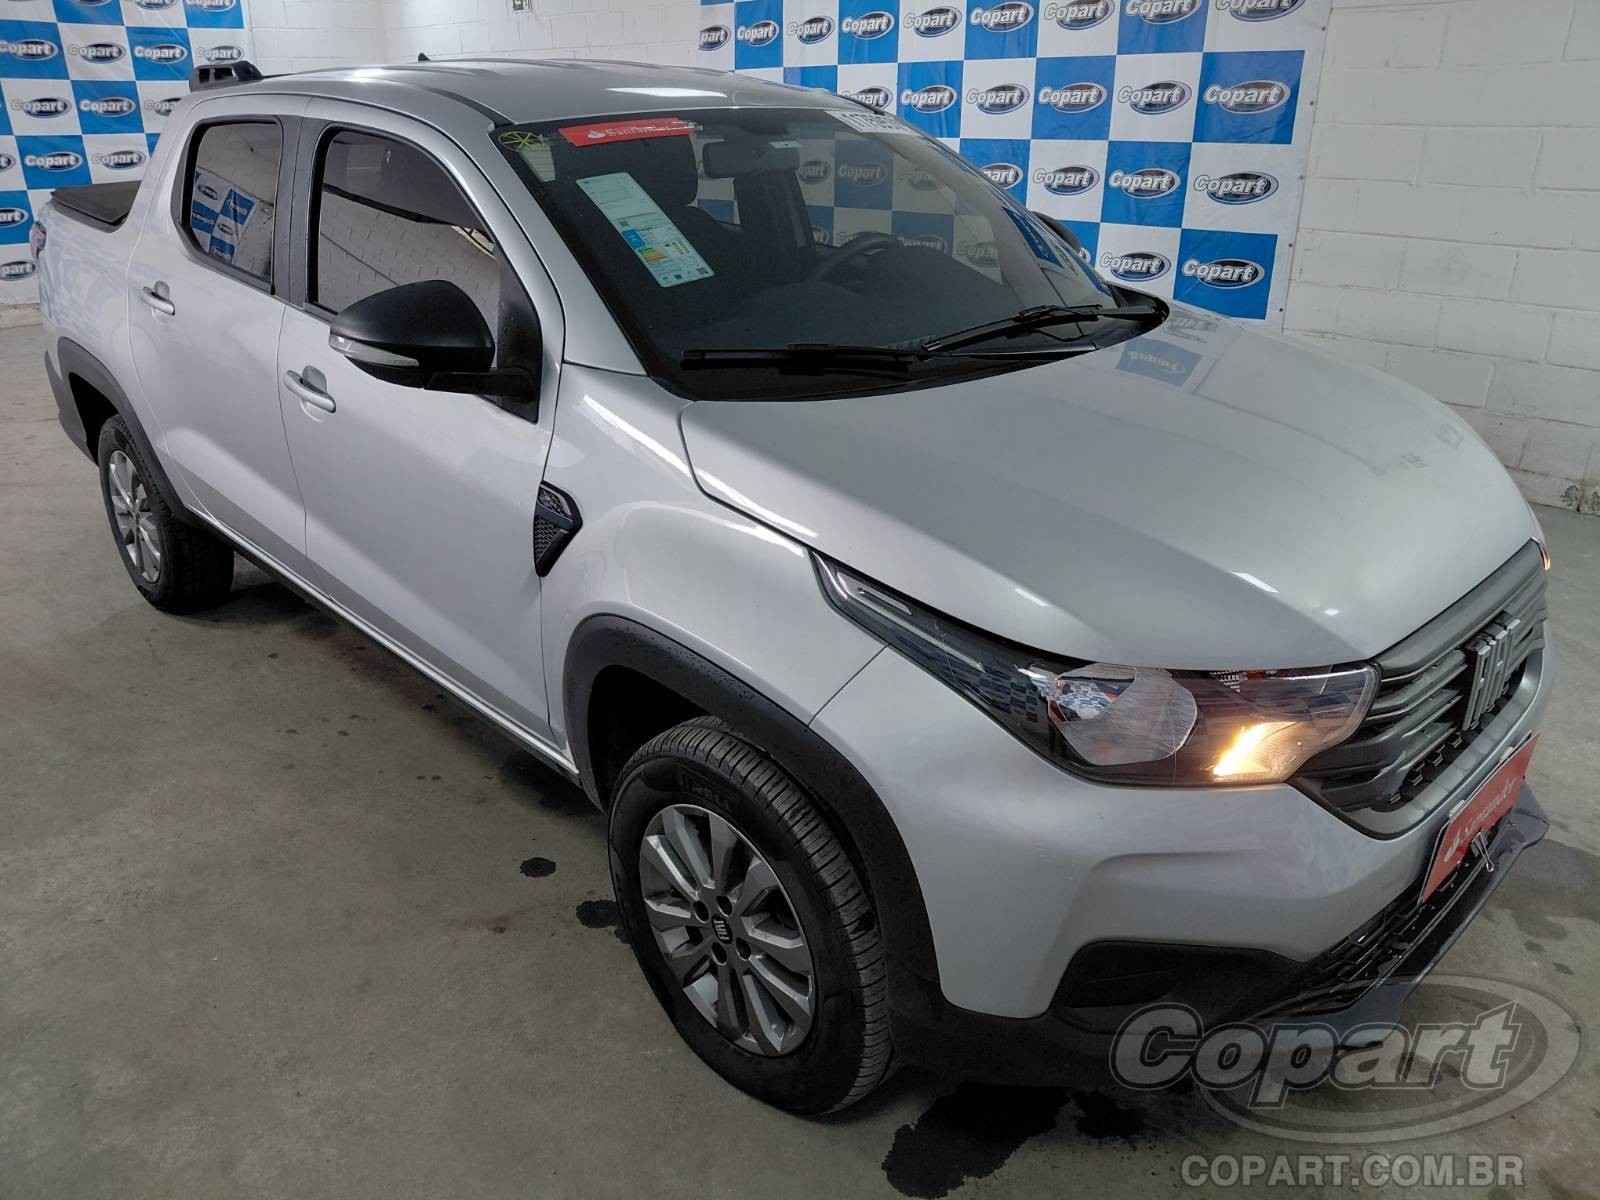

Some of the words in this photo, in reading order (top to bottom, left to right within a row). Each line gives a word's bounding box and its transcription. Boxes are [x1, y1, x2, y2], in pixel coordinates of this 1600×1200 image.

[970, 7, 1025, 27] Copart
[1044, 1, 1107, 24] Copart
[1125, 0, 1191, 19] Copart
[787, 21, 829, 40] Copart
[842, 15, 889, 35] Copart
[903, 11, 953, 32] Copart
[701, 30, 725, 43] part
[737, 24, 774, 41] Copart
[69, 44, 119, 59] Copart
[134, 46, 181, 60] Copart
[197, 47, 239, 61] Copart
[901, 86, 951, 108] Copart
[966, 87, 1025, 107] Copart
[1039, 86, 1100, 108] Copart
[1118, 85, 1185, 106] Copart
[1203, 84, 1282, 108] Copart
[11, 98, 64, 113] Copart
[79, 98, 130, 113] Copart
[144, 99, 176, 114] Copa
[24, 152, 77, 168] Copart
[91, 152, 139, 168] Copart
[838, 163, 881, 182] Copart
[1033, 167, 1092, 190] Copart
[1109, 169, 1171, 194] Copart
[1194, 173, 1268, 198] Copart
[0, 208, 22, 221] art
[0, 262, 33, 276] part
[1100, 252, 1163, 278] Copart
[1182, 259, 1260, 284] Copart
